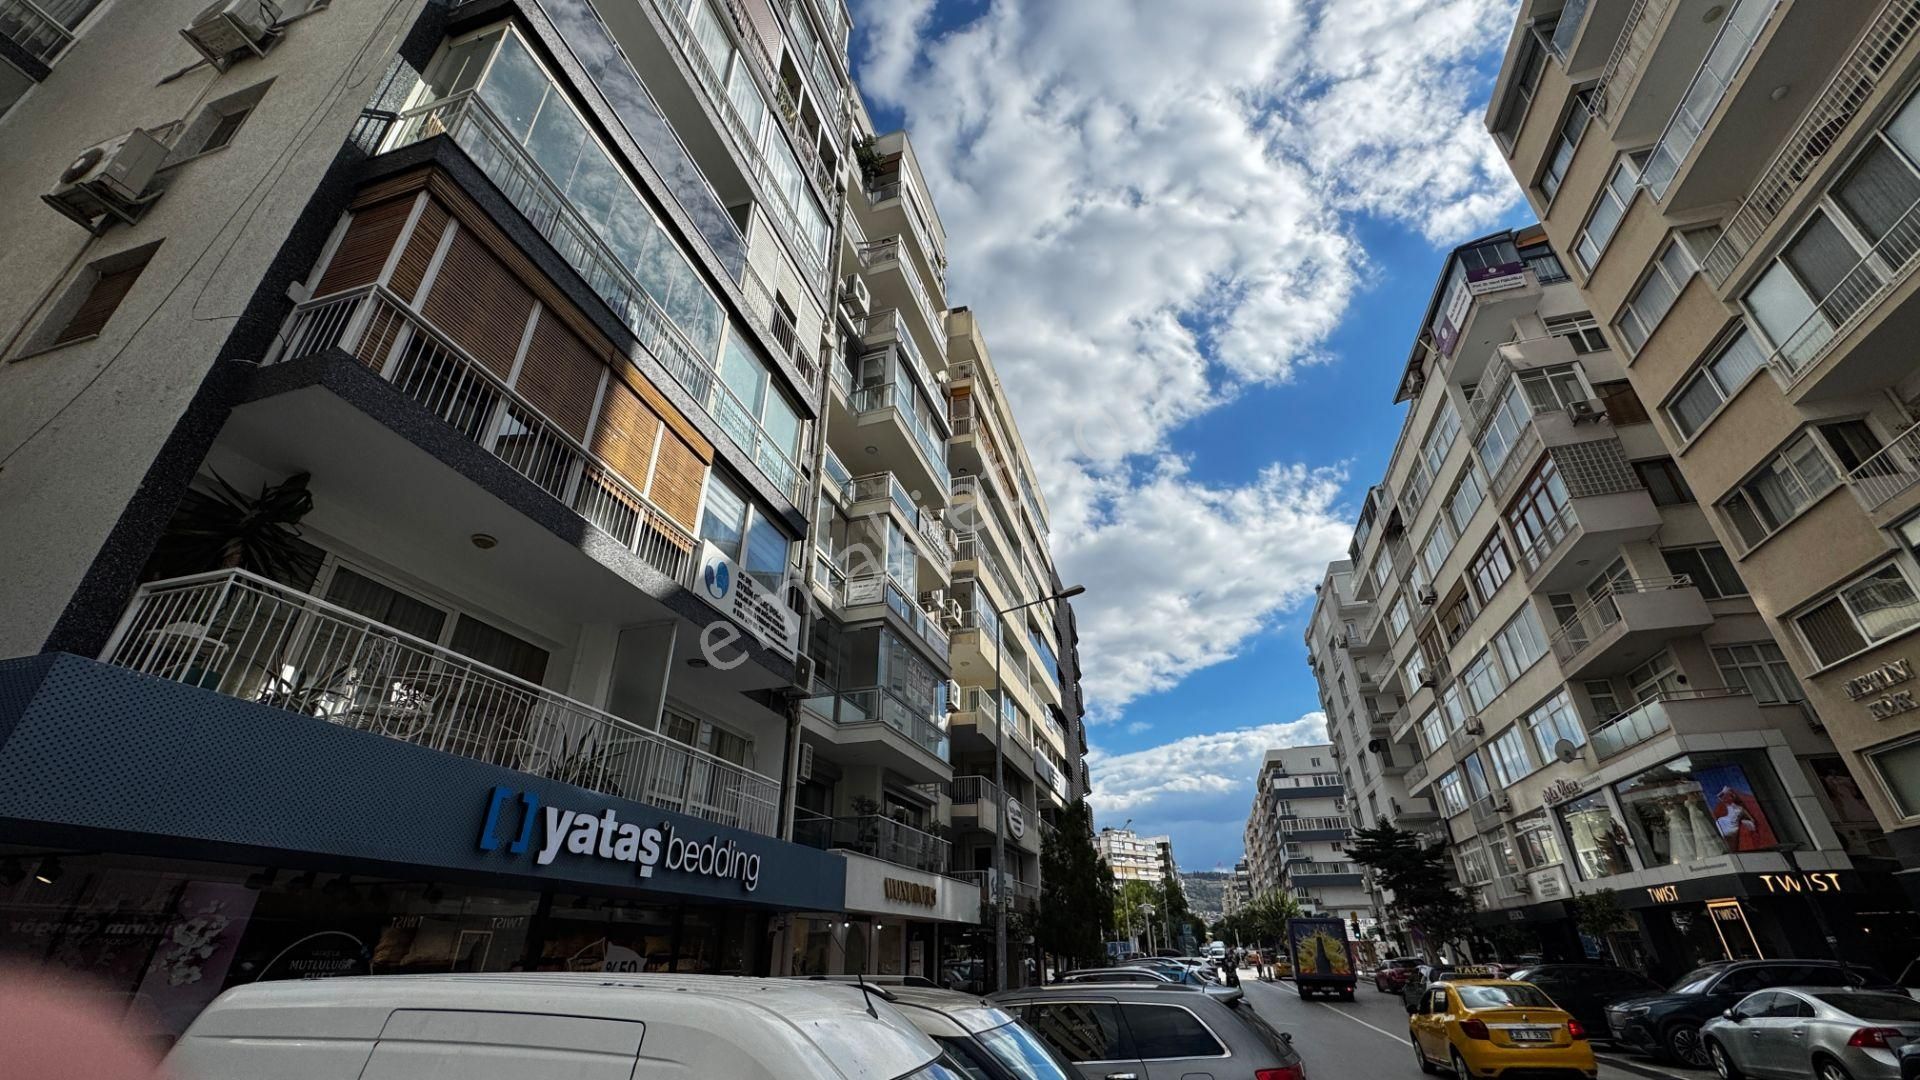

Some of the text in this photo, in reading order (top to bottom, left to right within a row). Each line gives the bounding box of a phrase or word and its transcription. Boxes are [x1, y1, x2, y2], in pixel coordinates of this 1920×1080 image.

[537, 806, 761, 892] yataş bedding
[1759, 873, 1842, 893] TWIST
[1647, 885, 1680, 903] TWIST
[1714, 908, 1741, 920] TWIST
